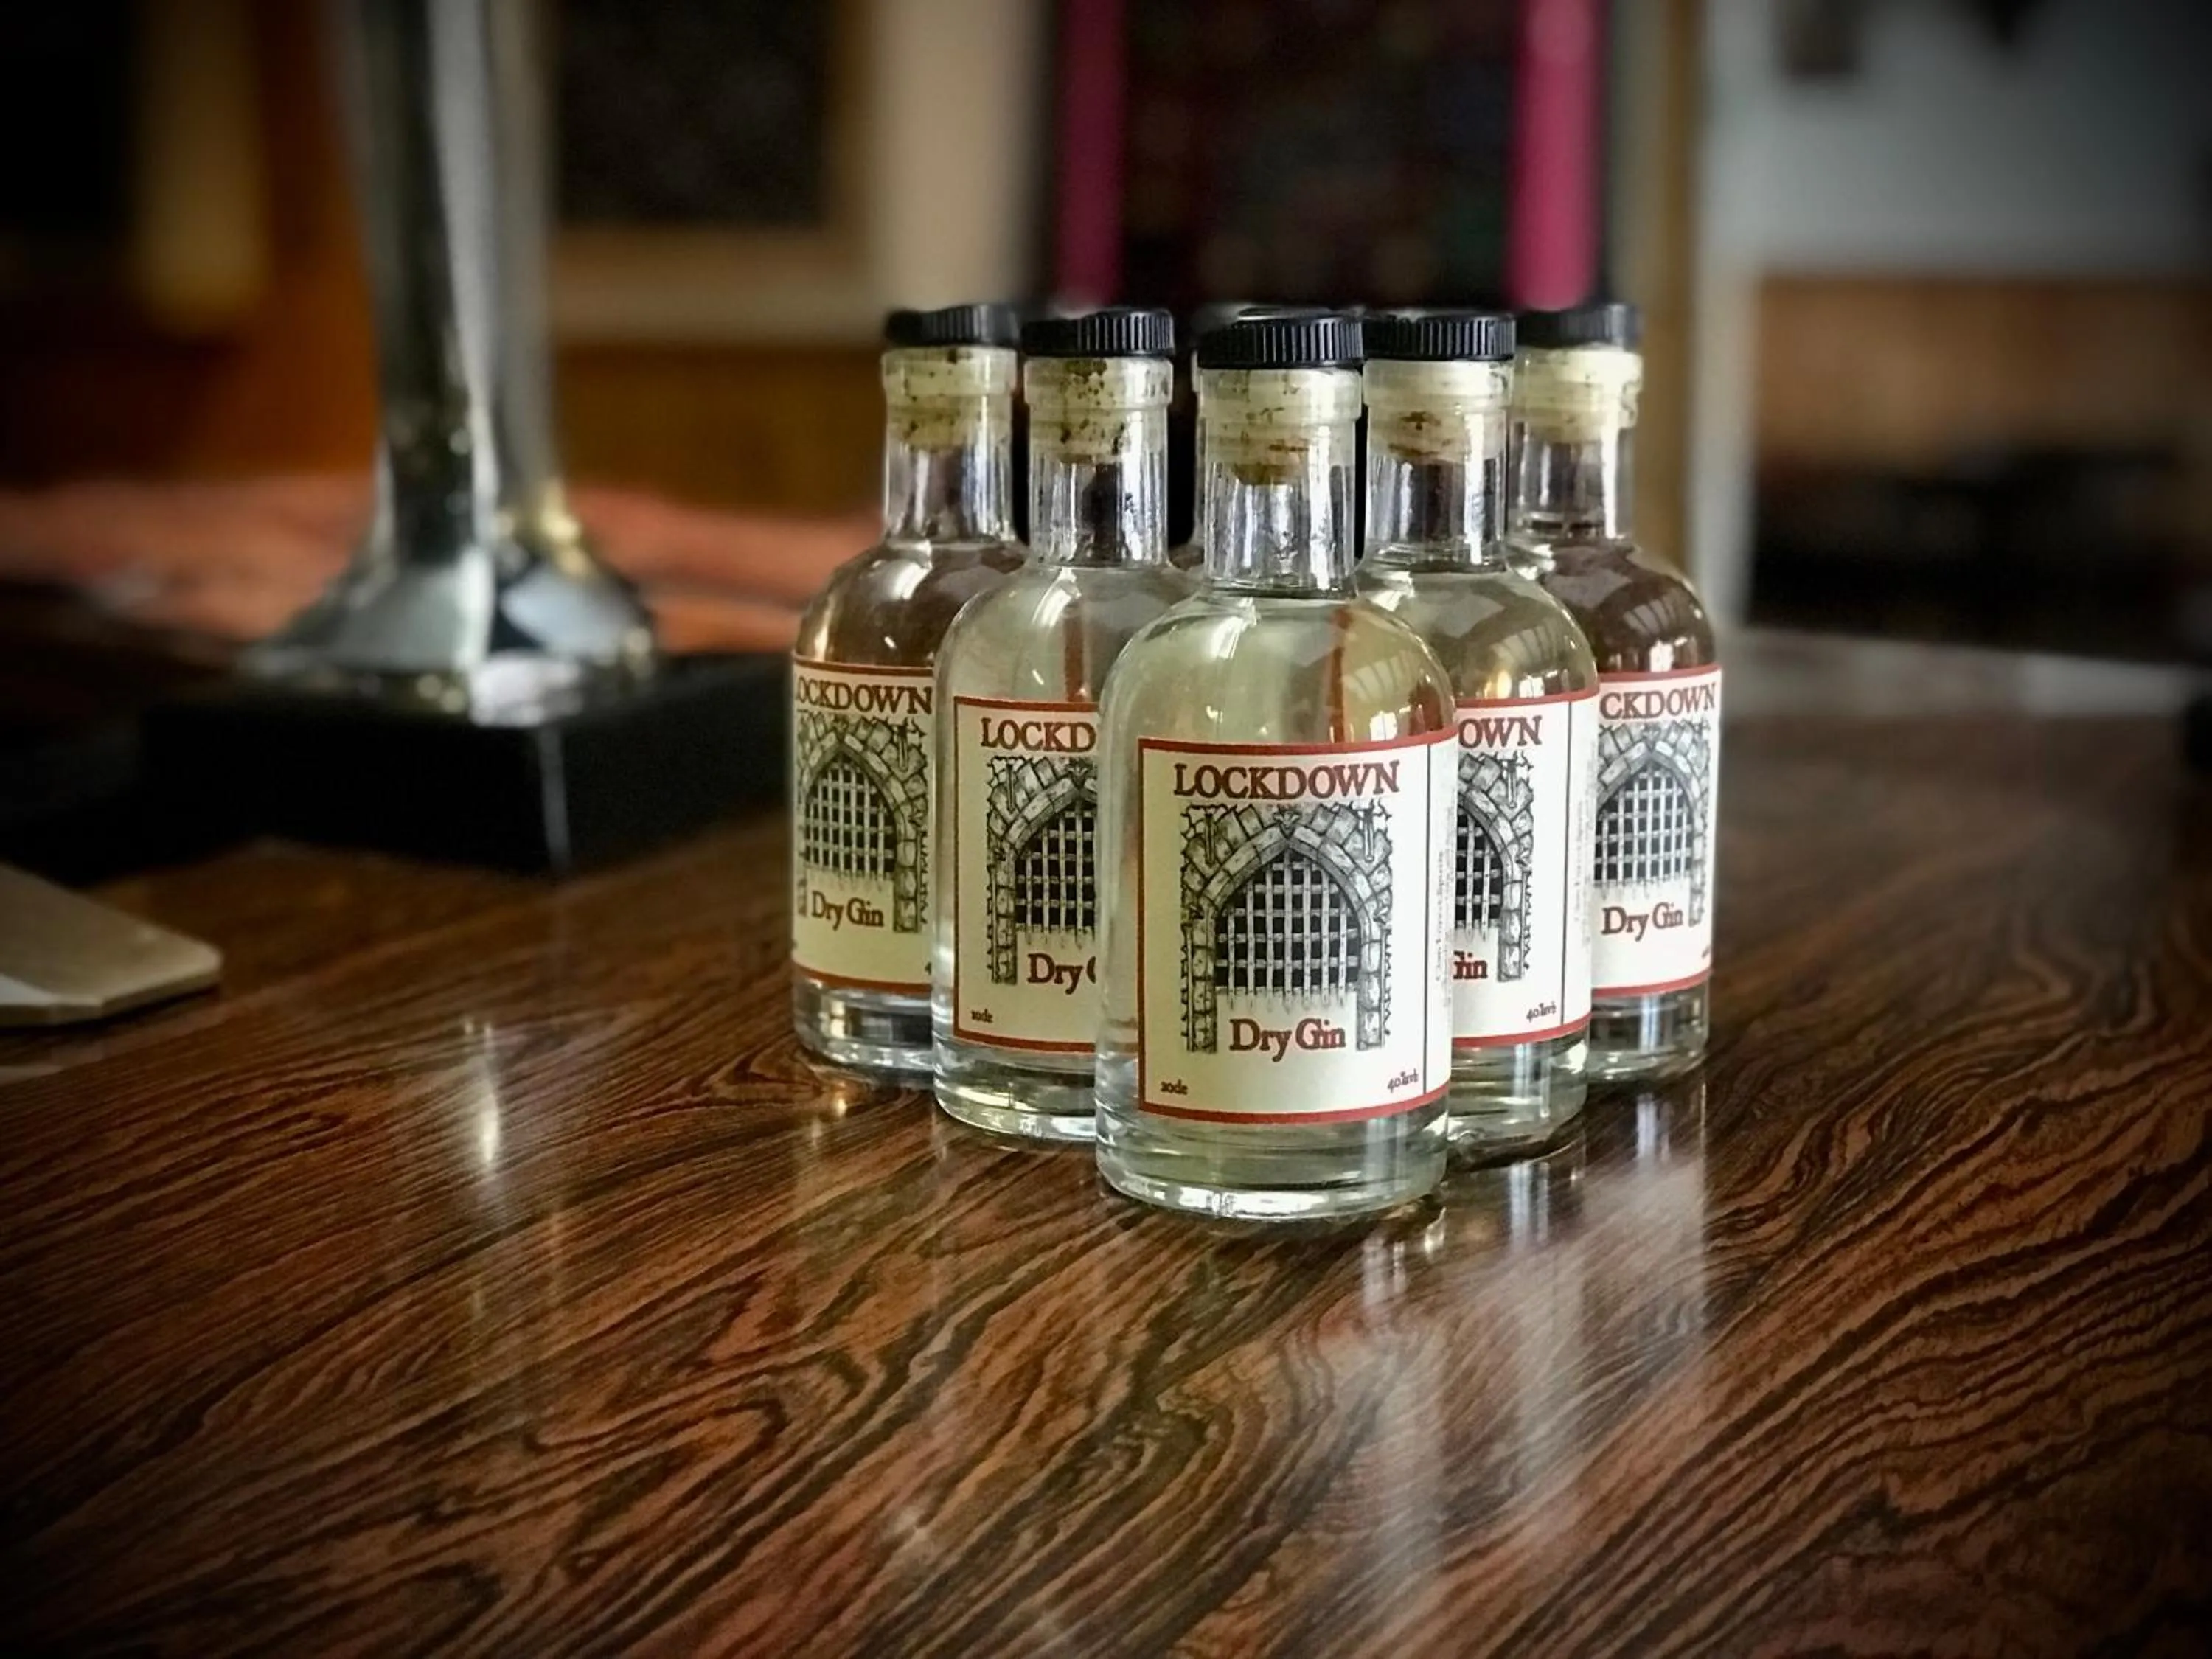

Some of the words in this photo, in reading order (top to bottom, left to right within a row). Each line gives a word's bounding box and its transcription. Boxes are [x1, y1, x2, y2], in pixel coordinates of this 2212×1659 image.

[796, 675, 933, 714] OCKDOWN
[1599, 683, 1716, 719] CKDOWN
[980, 717, 1096, 752] LOCKD
[1174, 759, 1400, 799] LOCKDOWN
[810, 891, 844, 931] Dry
[846, 897, 884, 927] Gin
[1601, 906, 1649, 942] Dry
[1652, 902, 1683, 929] Gin
[1027, 953, 1084, 995] Dry
[1229, 1018, 1291, 1062] Dry
[1295, 1018, 1346, 1051] Gin
